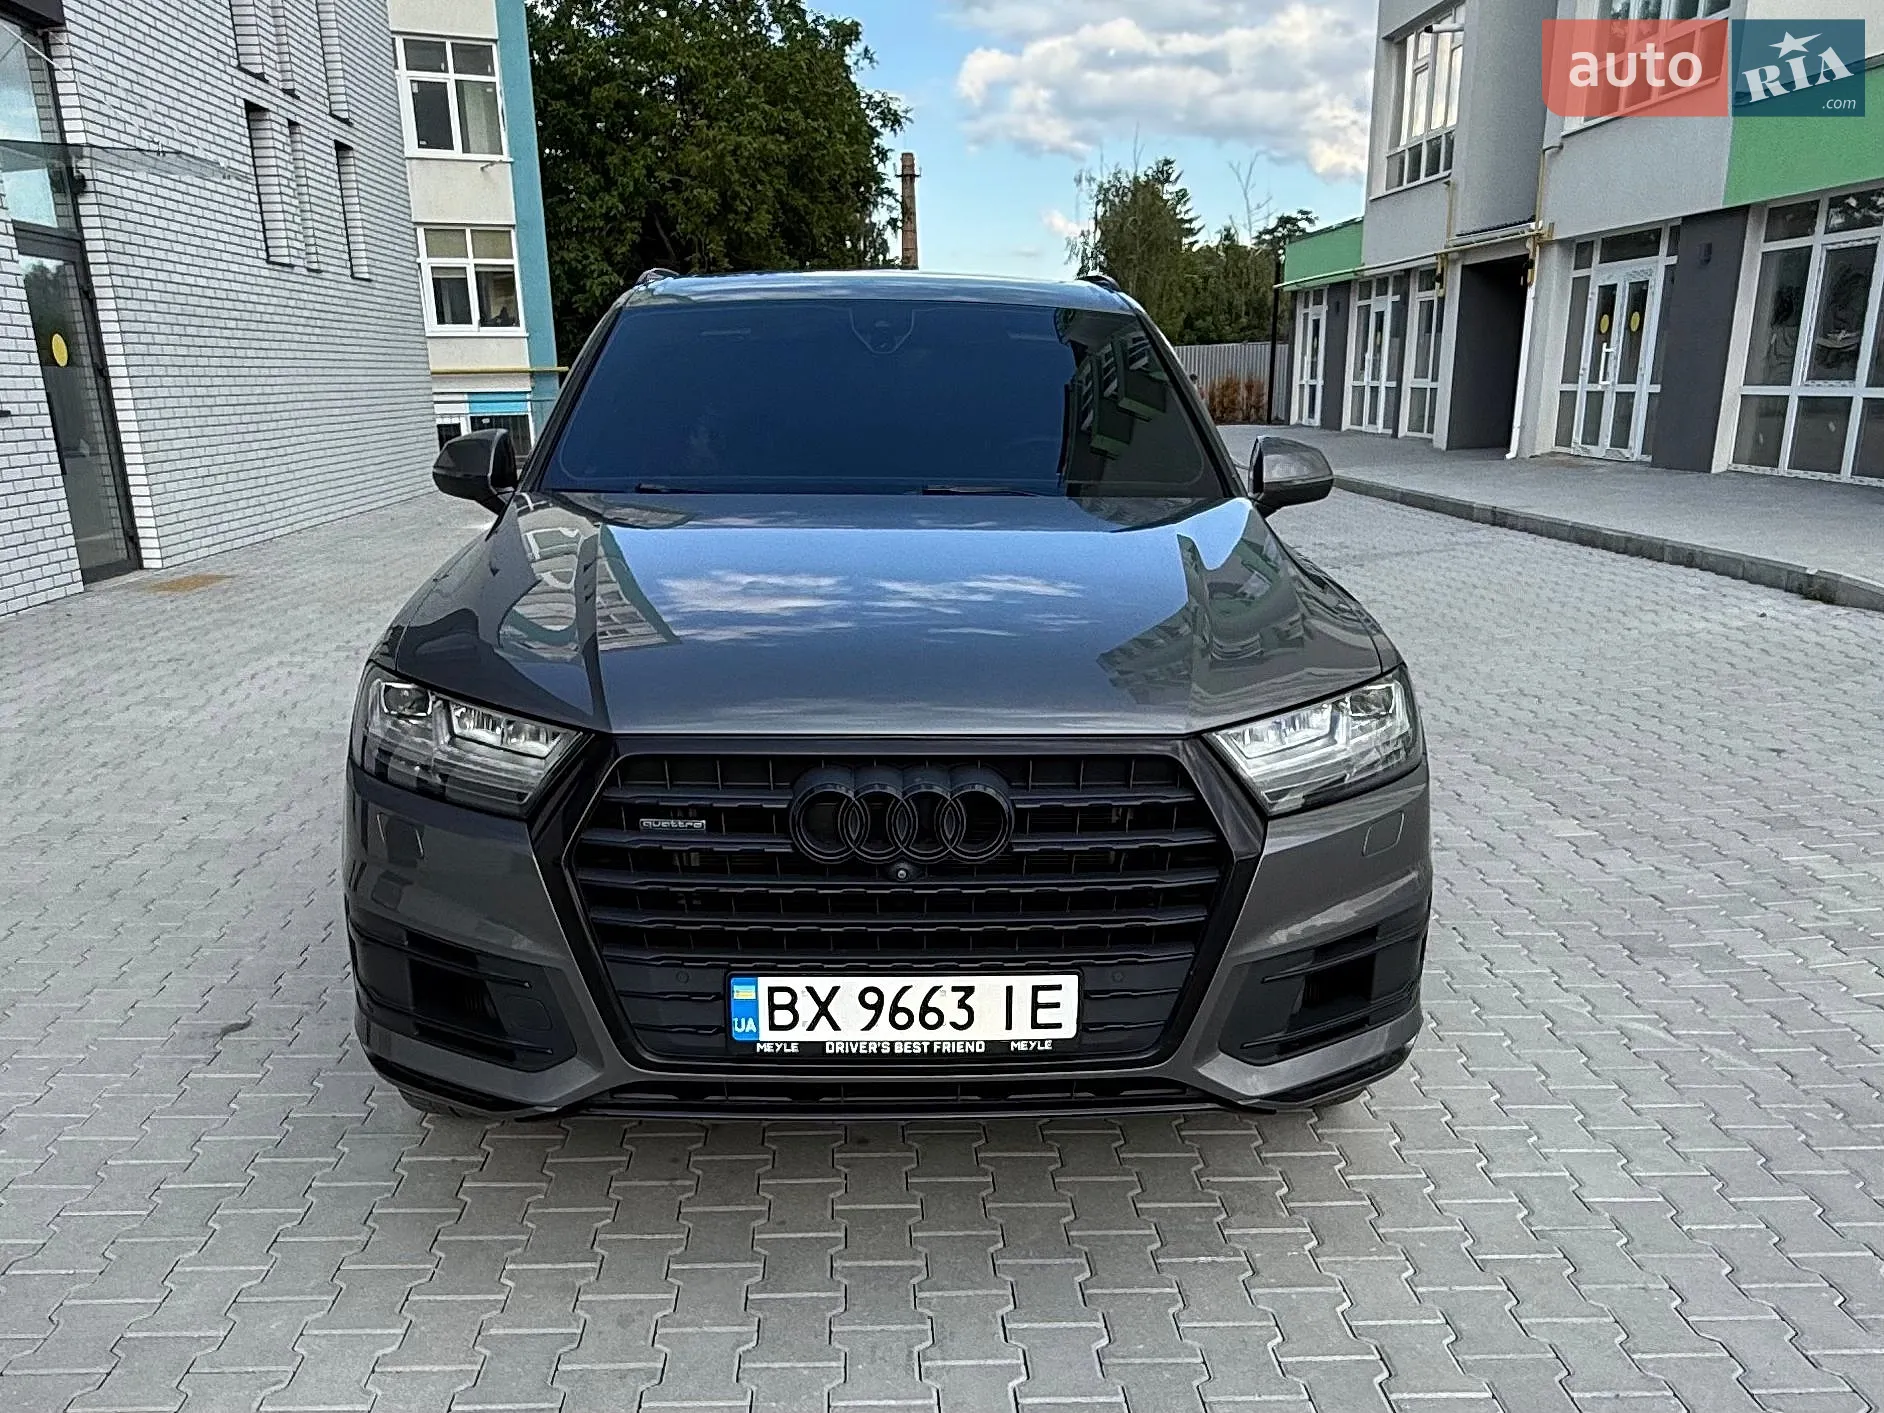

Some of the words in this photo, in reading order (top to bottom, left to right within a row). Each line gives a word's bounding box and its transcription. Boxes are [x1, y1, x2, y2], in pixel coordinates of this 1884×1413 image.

[642, 820, 703, 829] quattro
[767, 985, 841, 1032] BX
[857, 985, 975, 1031] 9663
[1004, 984, 1063, 1030] IE
[733, 1017, 757, 1032] UA
[756, 1042, 799, 1053] MEYLE
[825, 1041, 890, 1054] DRIVER'S
[895, 1041, 929, 1053] BEST
[933, 1041, 985, 1053] FRIEND
[1010, 1040, 1053, 1051] MEYLE
